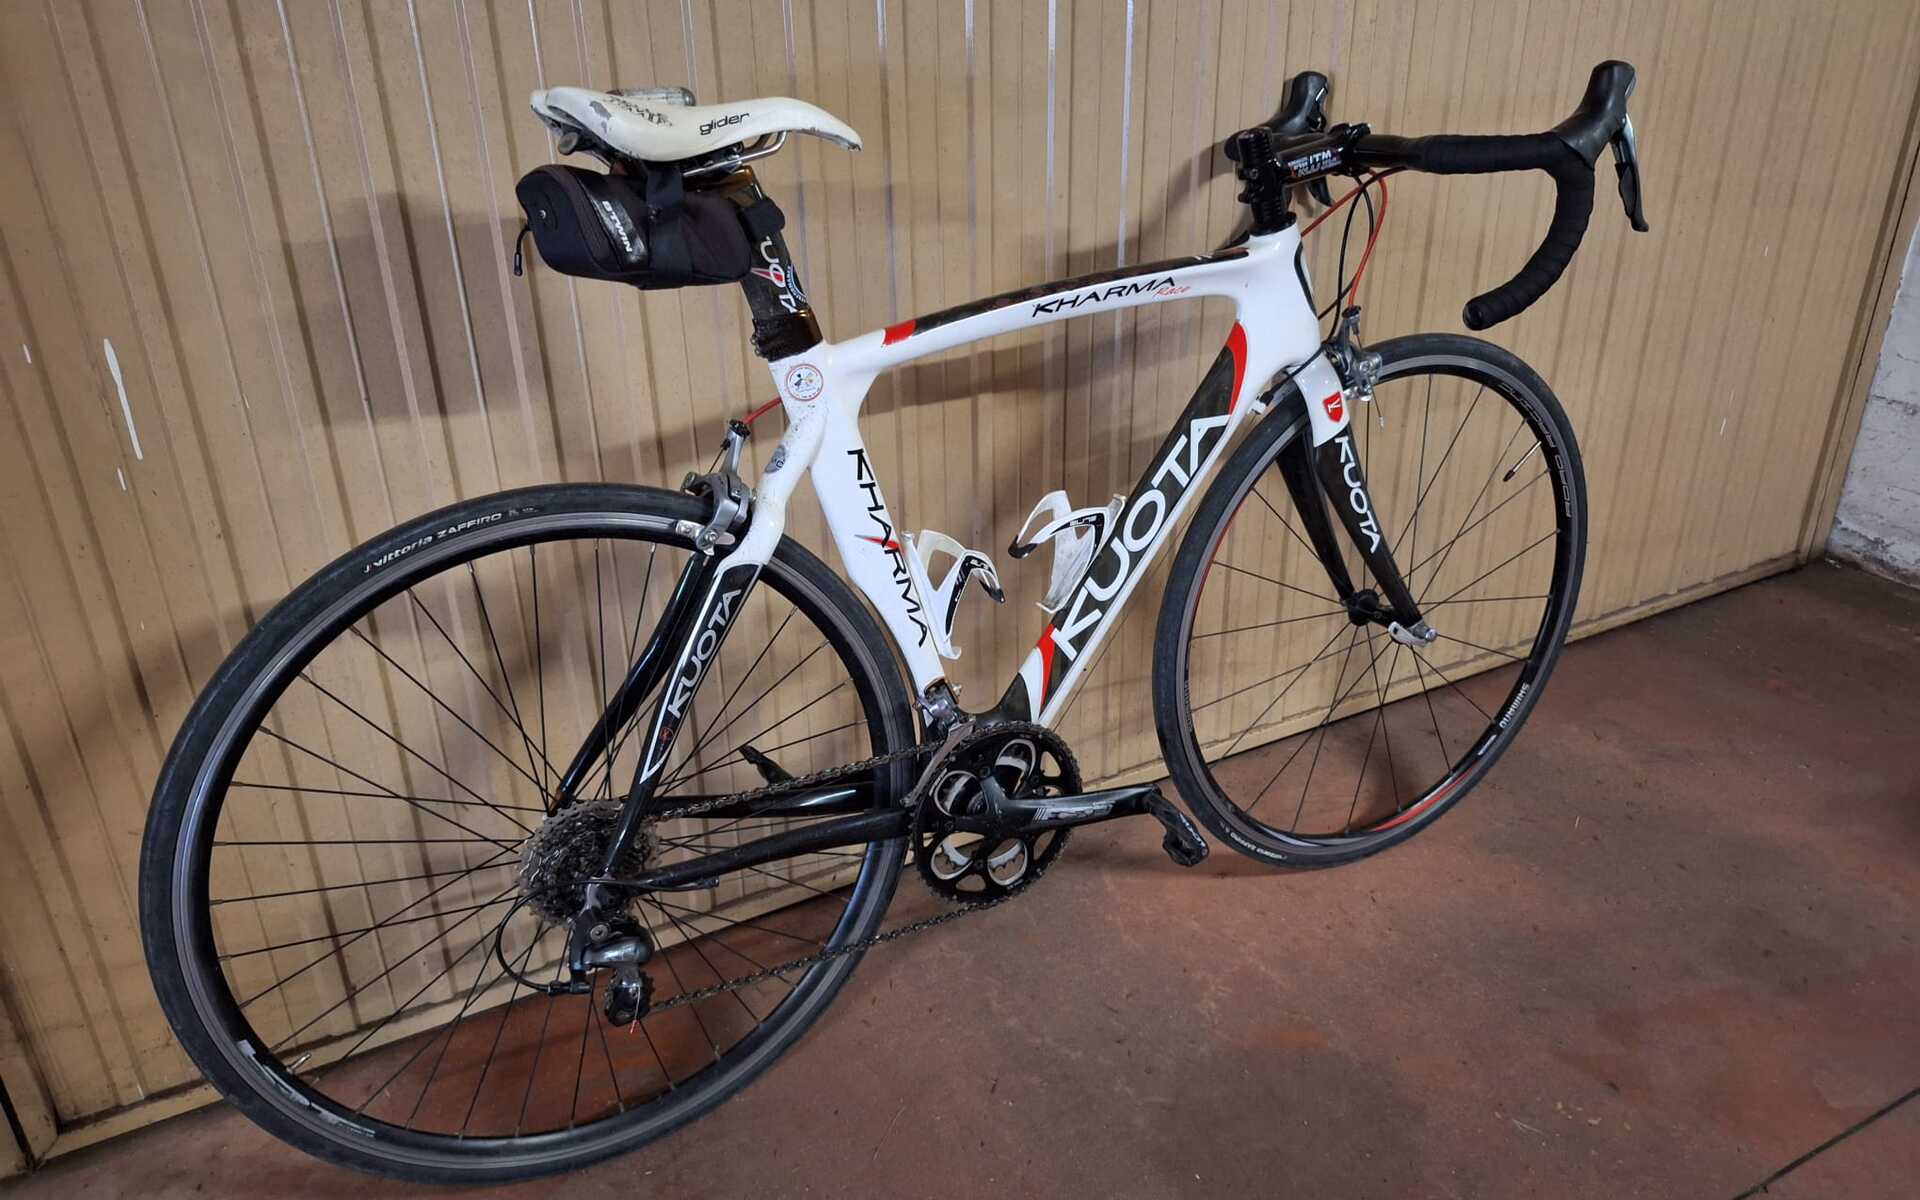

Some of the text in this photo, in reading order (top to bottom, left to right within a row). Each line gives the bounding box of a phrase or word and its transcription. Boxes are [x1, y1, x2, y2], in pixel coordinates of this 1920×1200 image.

[699, 112, 750, 135] glider
[1309, 150, 1332, 165] ITM
[1032, 276, 1175, 318] KHARMA
[436, 512, 502, 539] ZAFFIRO
[1335, 435, 1381, 554] KUOTA
[847, 448, 927, 648] KHARMA
[1050, 414, 1232, 661] KUOTA
[667, 589, 742, 719] KUOTA
